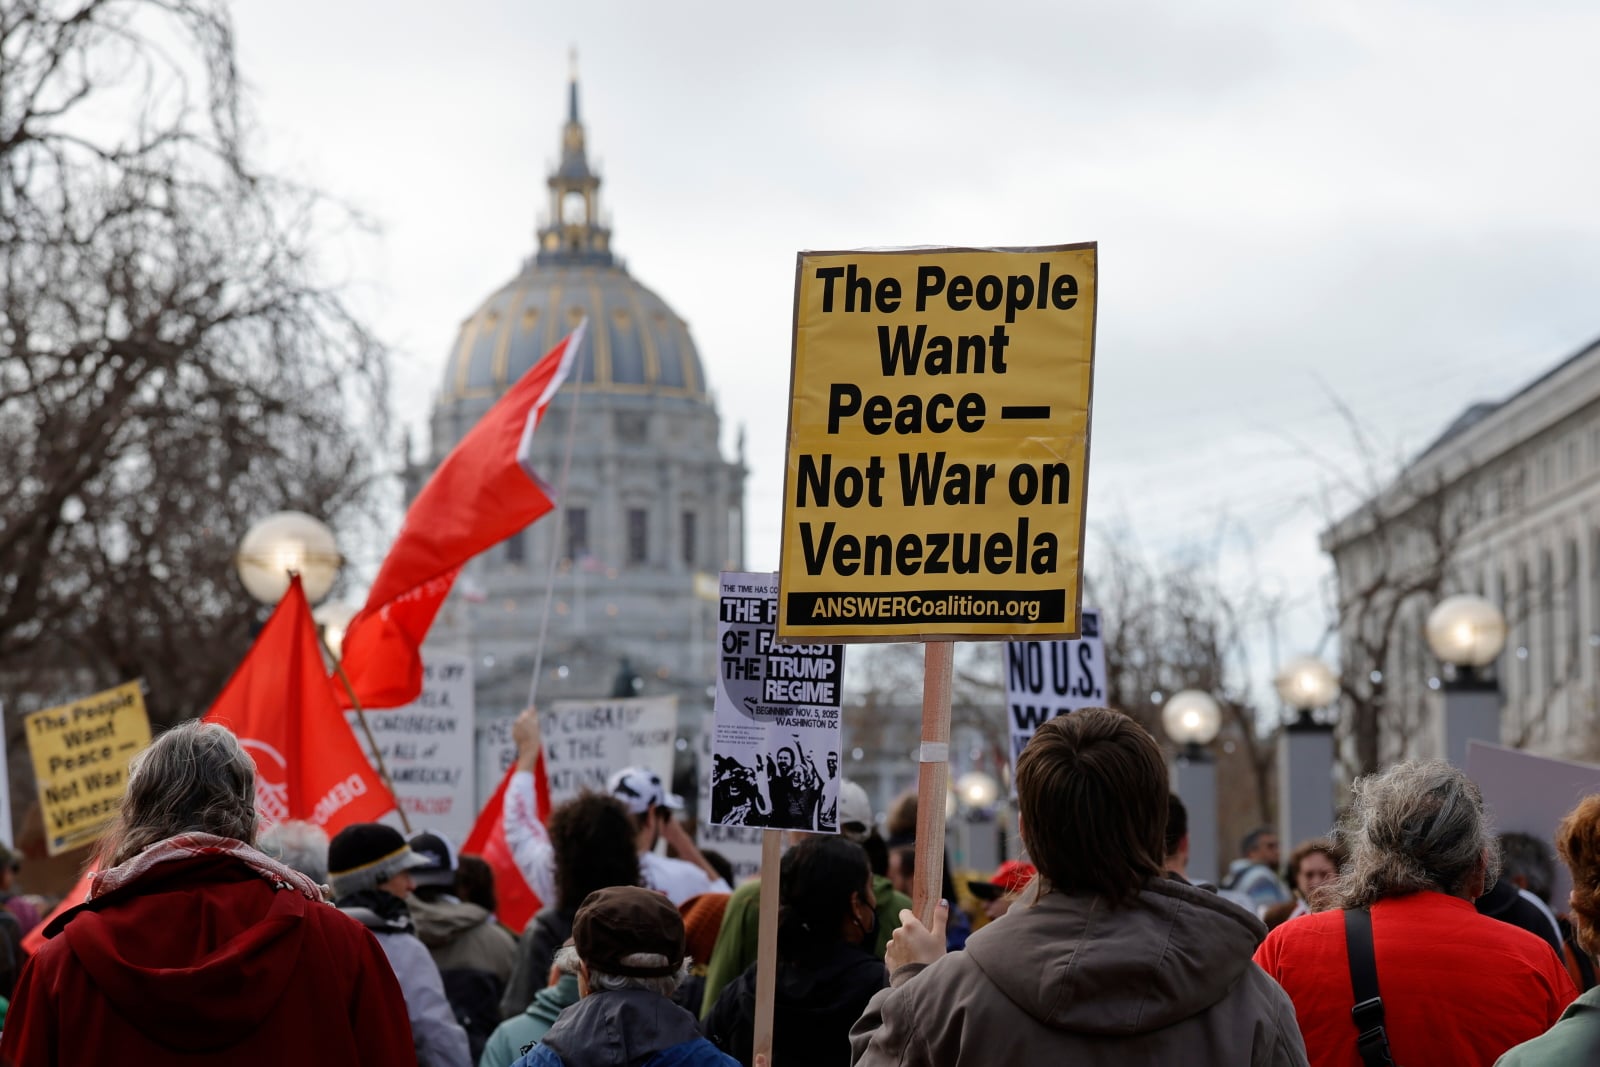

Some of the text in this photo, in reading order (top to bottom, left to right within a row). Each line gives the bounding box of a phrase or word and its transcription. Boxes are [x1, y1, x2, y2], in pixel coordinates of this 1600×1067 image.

[816, 262, 1078, 323] The People
[877, 325, 1009, 376] Want
[827, 383, 986, 435] Peace
[796, 452, 1070, 508] Not War on
[799, 517, 1058, 576] Venezuela
[723, 584, 778, 594] THE TIME HAS CO
[723, 599, 760, 622] THE
[811, 596, 1040, 621] ANSWERCoalition.org
[722, 630, 749, 654] OF
[723, 656, 835, 680] THE TRUMP
[1009, 642, 1102, 699] NO U.S.
[765, 680, 834, 704] REGIME
[34, 693, 134, 733] The People
[755, 706, 839, 719] BEGINNING NOV. 5, 2025
[776, 717, 838, 729] WASHINGTON DC
[62, 720, 116, 749] Want
[49, 747, 111, 774] Peace
[46, 769, 122, 804] Not War
[314, 773, 368, 826] DEMO
